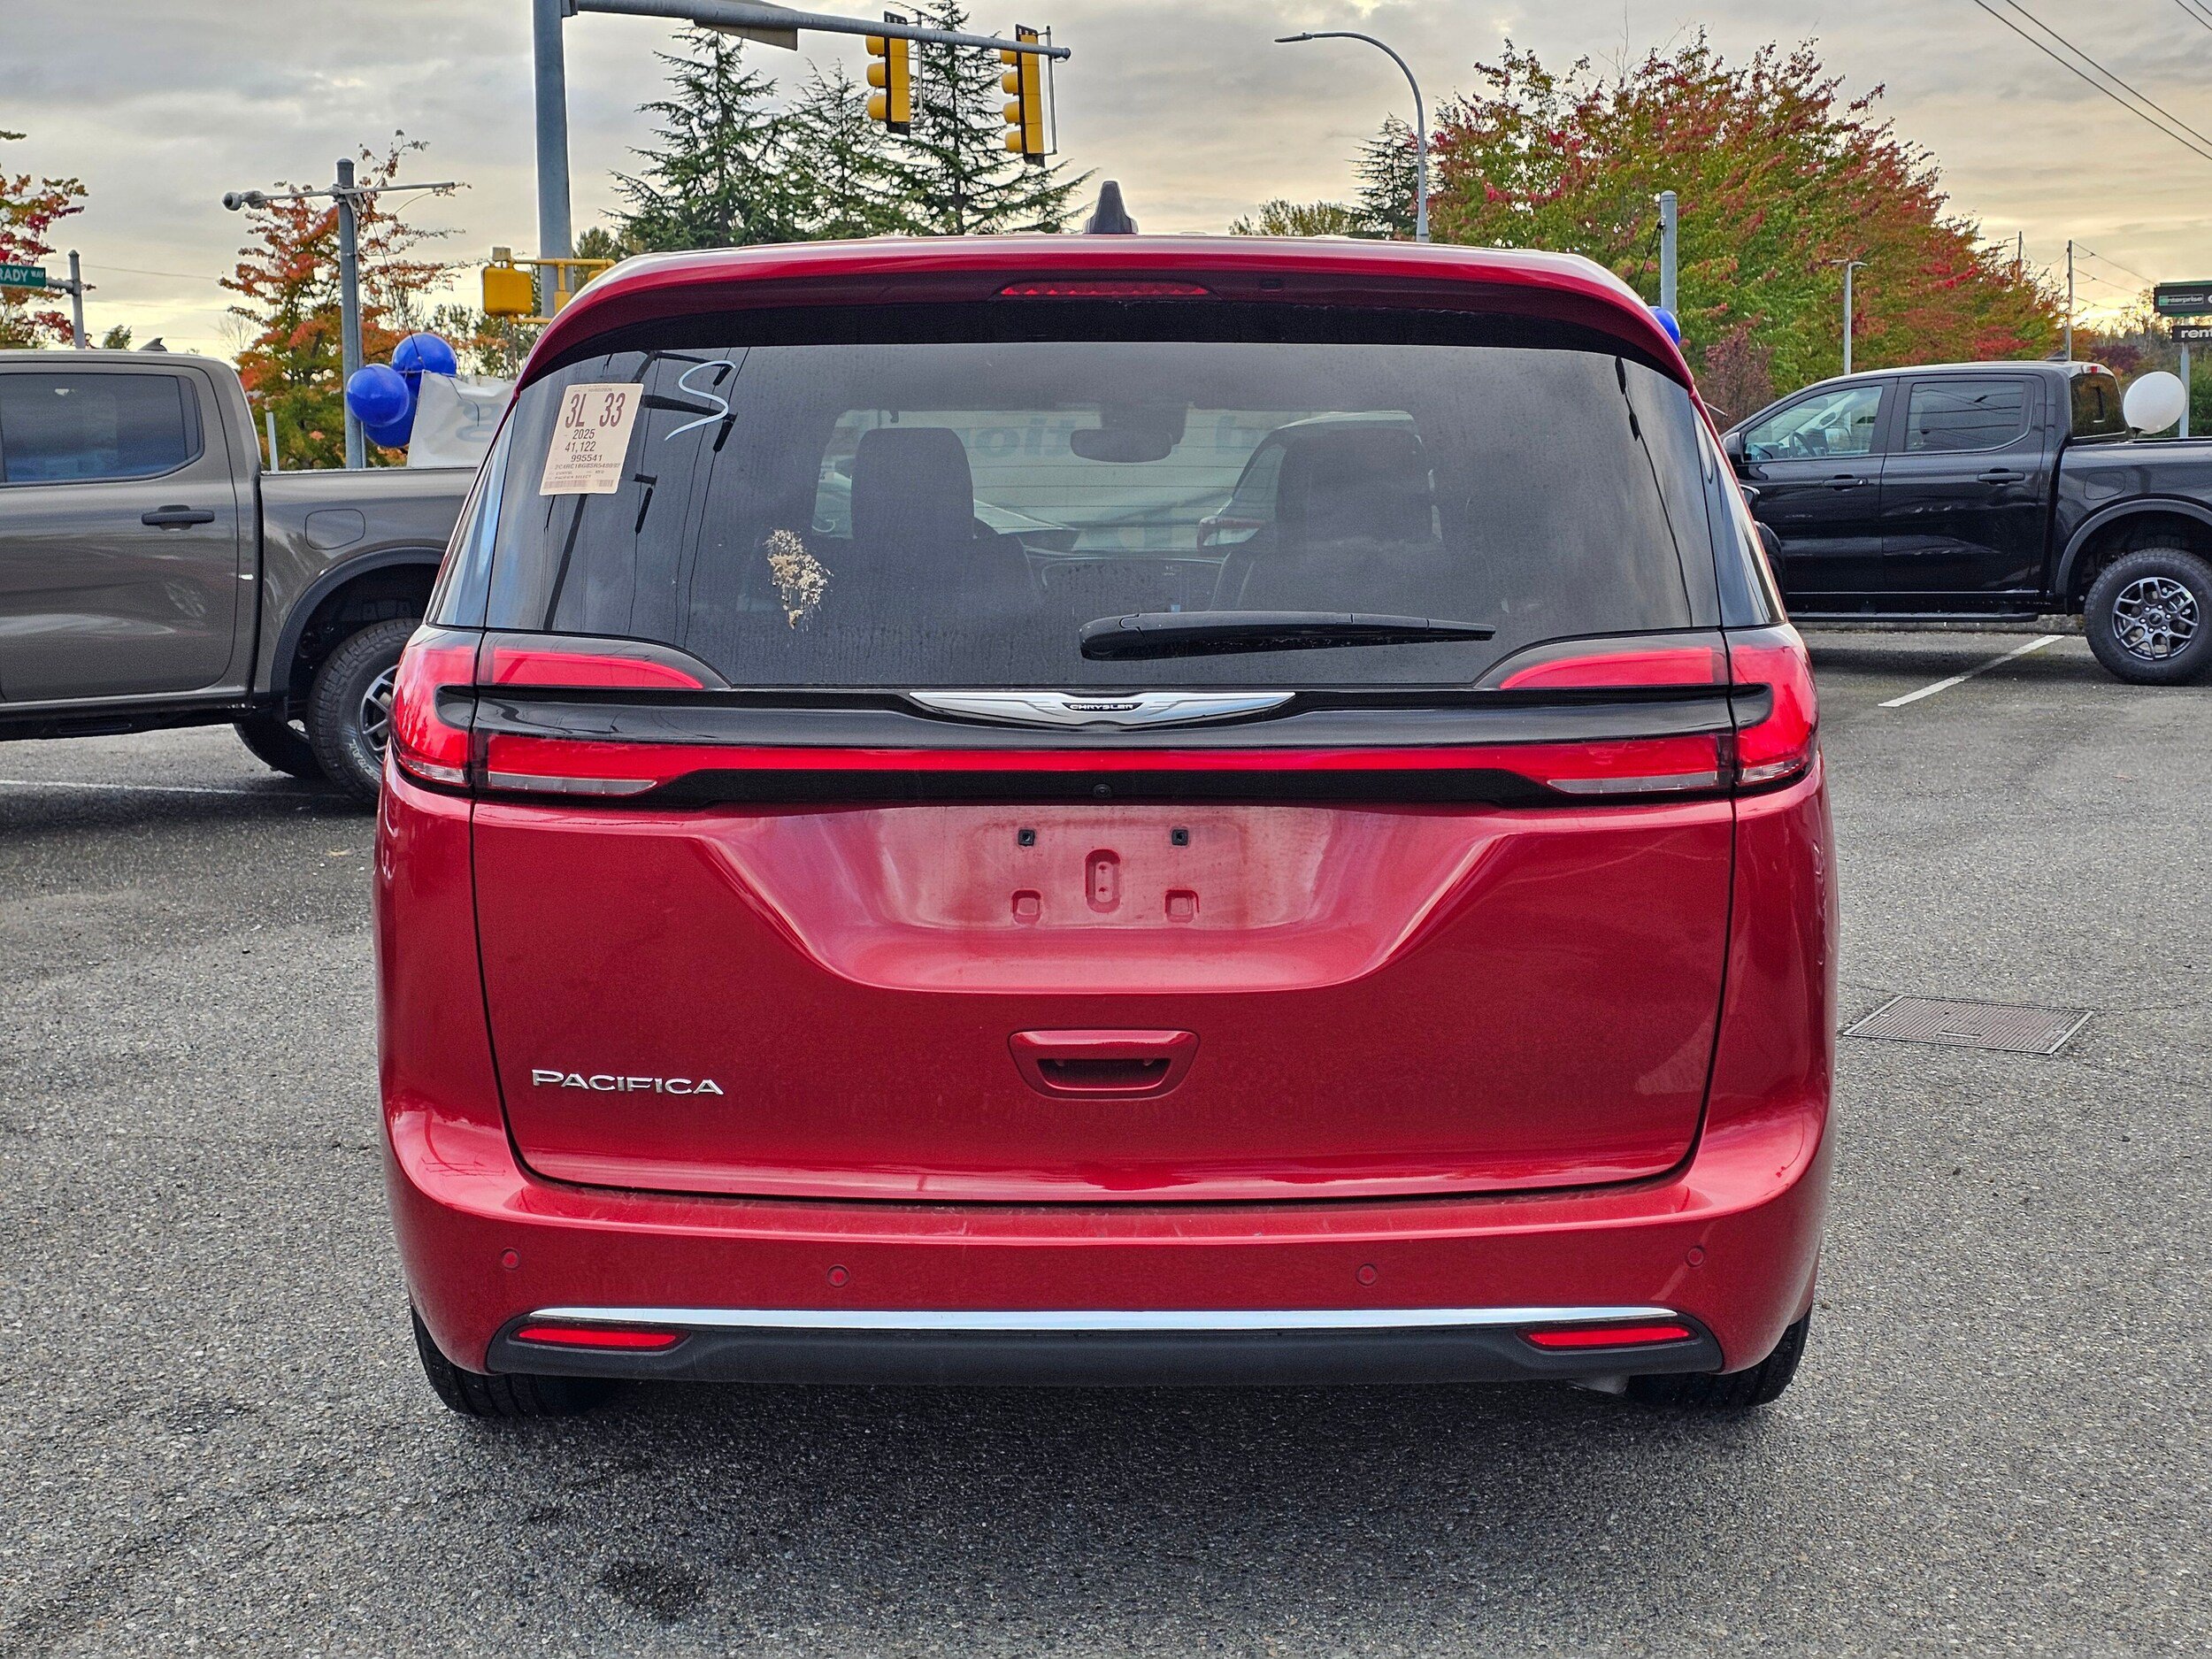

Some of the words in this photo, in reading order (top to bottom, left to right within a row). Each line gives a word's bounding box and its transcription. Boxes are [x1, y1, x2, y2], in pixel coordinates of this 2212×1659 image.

[30, 269, 44, 279] WAY
[565, 393, 587, 428] 3L
[599, 392, 626, 427] 33
[572, 428, 595, 440] 2025
[565, 441, 596, 453] 41,122
[571, 454, 603, 463] 995541
[531, 1069, 725, 1095] PACIFICA
